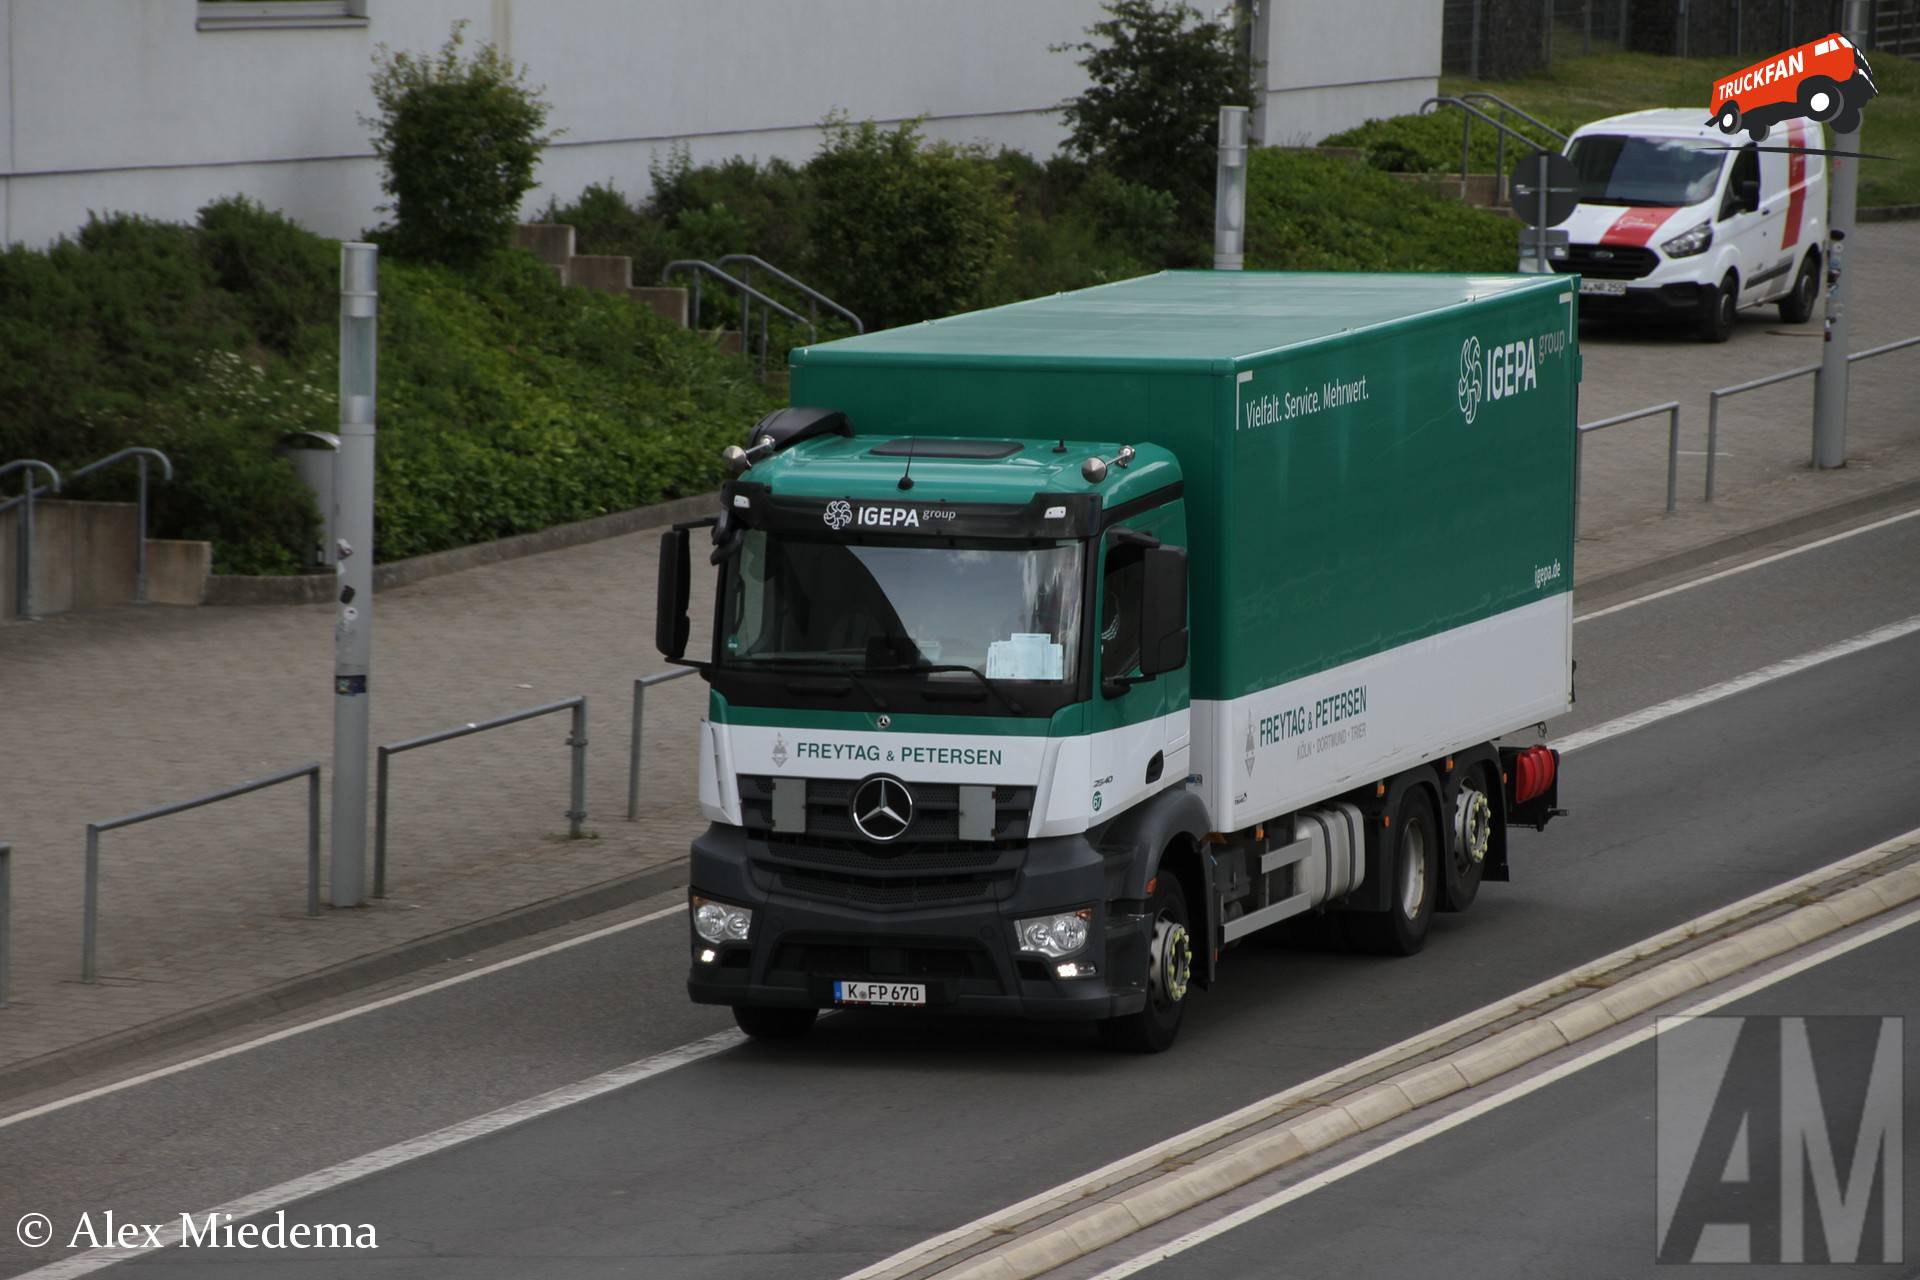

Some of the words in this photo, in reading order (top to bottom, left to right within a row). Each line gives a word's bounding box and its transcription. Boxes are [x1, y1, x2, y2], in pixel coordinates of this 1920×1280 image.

[1487, 338, 1537, 401] IGEPA
[1539, 330, 1565, 365] group
[1246, 394, 1282, 429] Vielfalt.
[1285, 387, 1320, 419] Service.
[1323, 375, 1369, 409] Mehrwert.
[858, 507, 919, 527] IGEPA
[923, 510, 956, 520] group
[1535, 558, 1560, 589] igepa.de
[1260, 706, 1305, 747] FREYTAG
[1308, 711, 1313, 730] &
[1316, 685, 1367, 728] PETERSEN
[797, 742, 880, 761] FREYTAG
[886, 750, 895, 761] &
[901, 747, 1002, 765] PETERSEN
[848, 984, 857, 999] K
[868, 985, 887, 999] FP
[891, 986, 919, 1001] 670
